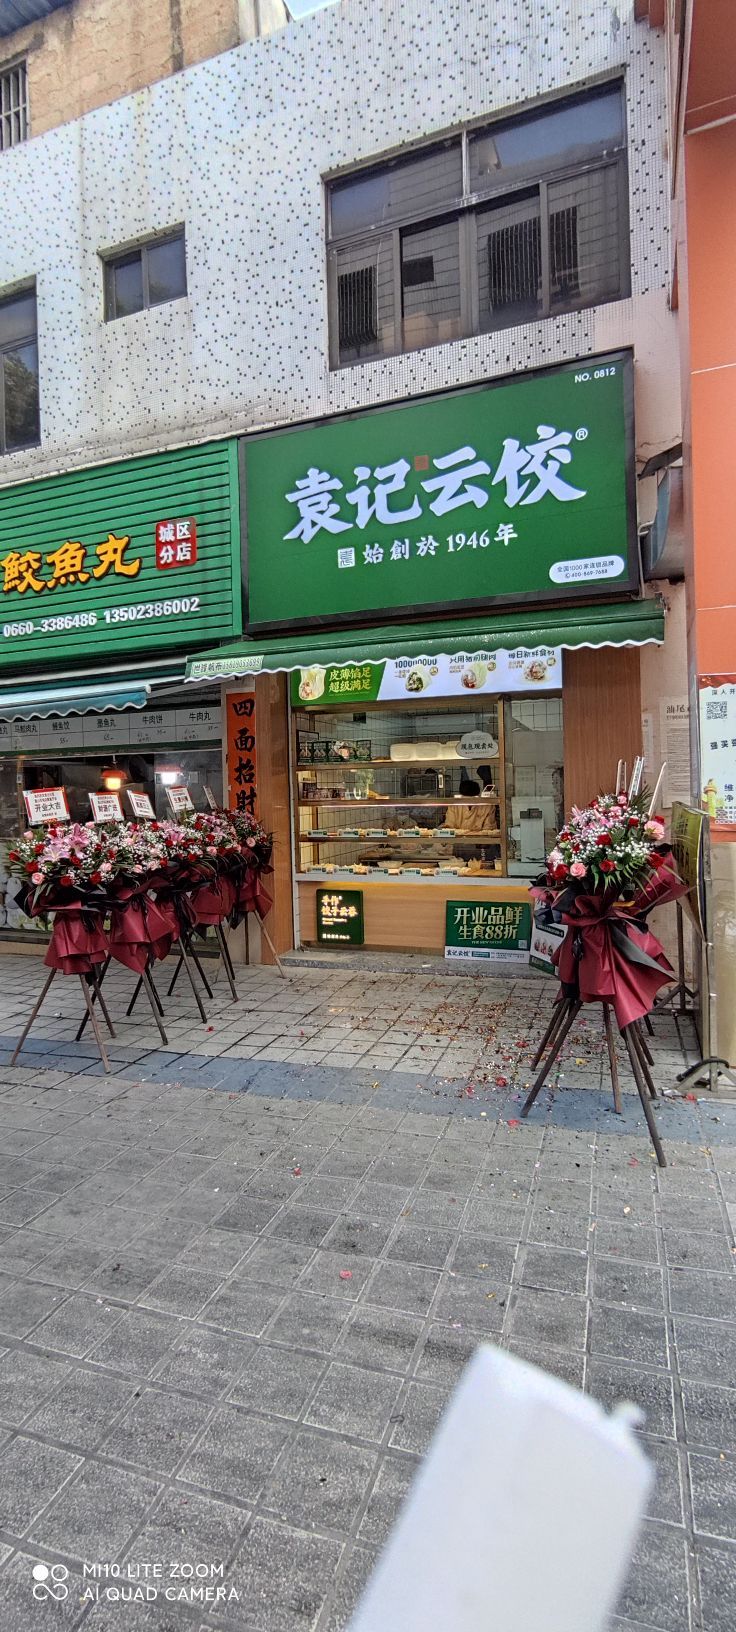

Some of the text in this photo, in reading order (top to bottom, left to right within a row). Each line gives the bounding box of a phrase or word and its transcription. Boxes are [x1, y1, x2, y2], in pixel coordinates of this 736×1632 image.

[574, 367, 617, 384] NO. 0812
[283, 425, 588, 544] 袁记云饺
[158, 521, 192, 542] 城区
[158, 543, 192, 564] 分店
[3, 598, 201, 638] 0660-3386486 13502386002
[329, 667, 372, 681] 皮薄馅足
[328, 679, 372, 693] 超级满足
[142, 715, 163, 725] 牛肉饼
[189, 711, 211, 721] 牛肉丸
[725, 794, 734, 802] 净
[34, 801, 61, 813] 开业大吉
[453, 906, 524, 925] 开业品鲜
[457, 924, 518, 940] 生食88折
